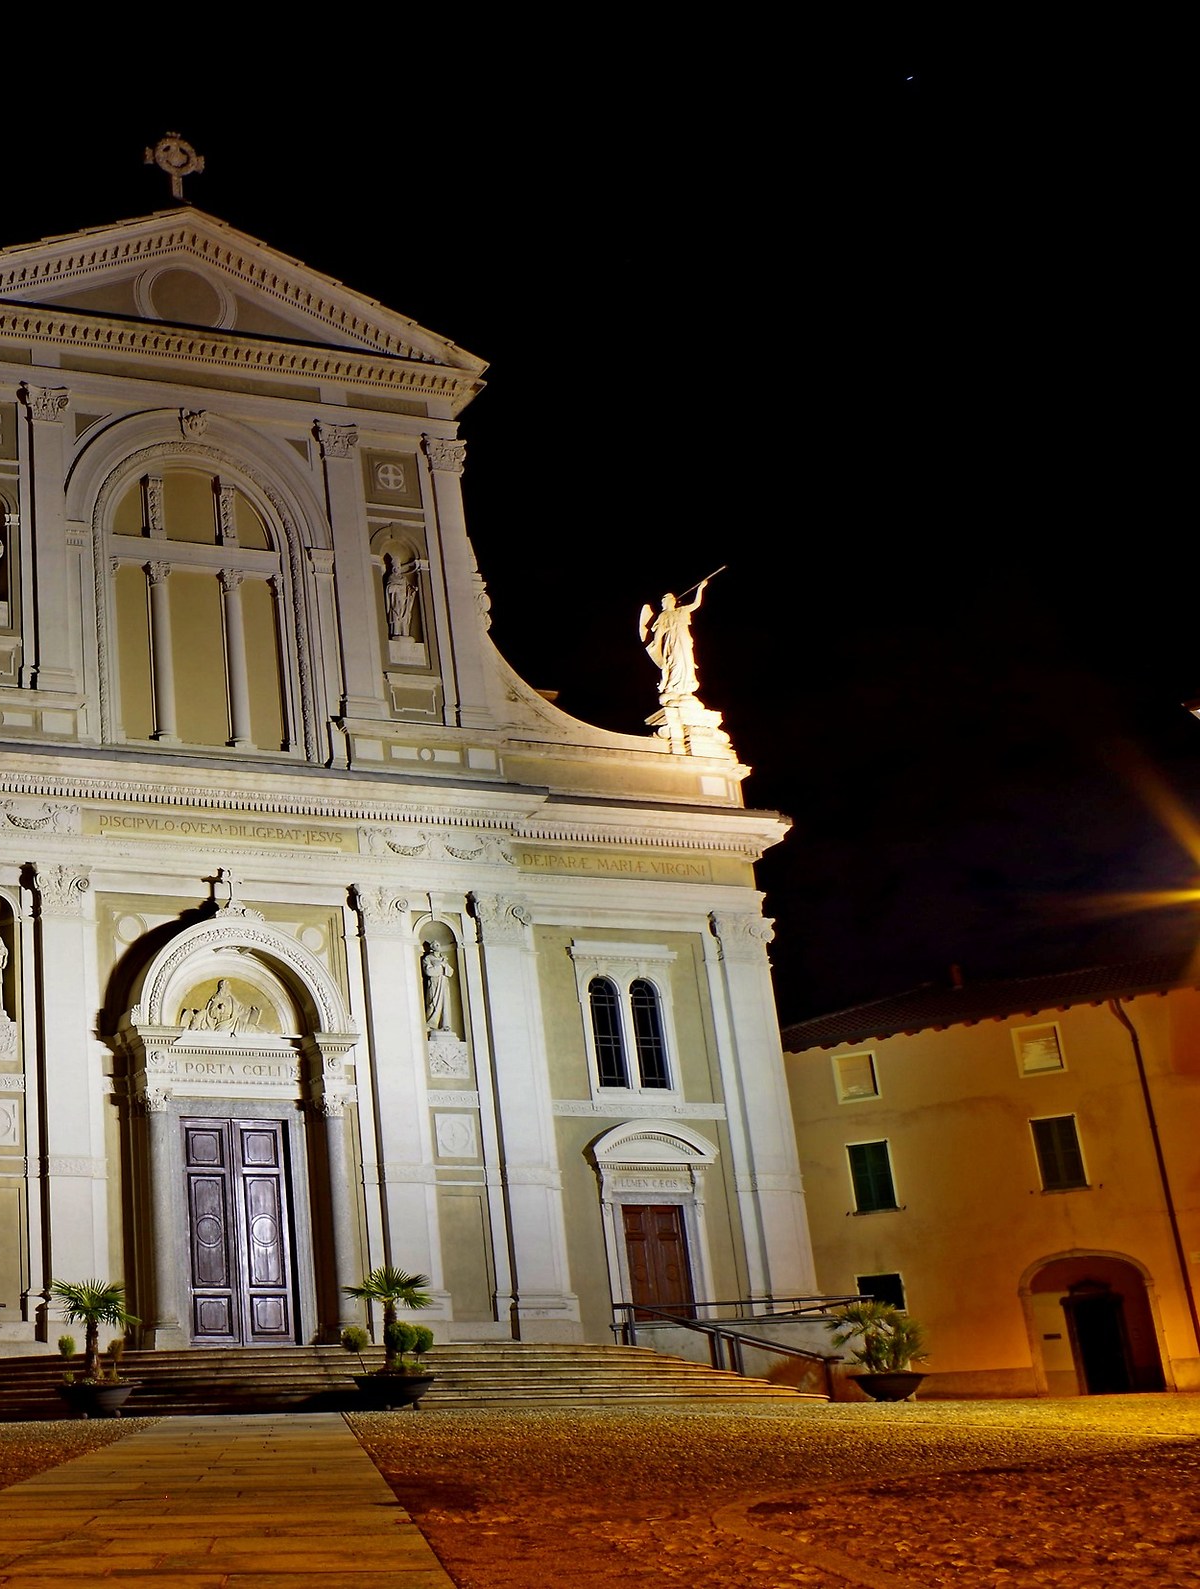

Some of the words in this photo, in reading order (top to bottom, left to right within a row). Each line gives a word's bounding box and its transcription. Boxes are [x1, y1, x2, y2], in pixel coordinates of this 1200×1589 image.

[99, 815, 175, 832] DISCIPVLO
[180, 821, 223, 835] QVEM
[229, 825, 301, 840] DILIGEBAT
[650, 862, 706, 877] VIRGINI
[185, 1062, 235, 1075] PORTA
[621, 1179, 649, 1188] LUMEN
